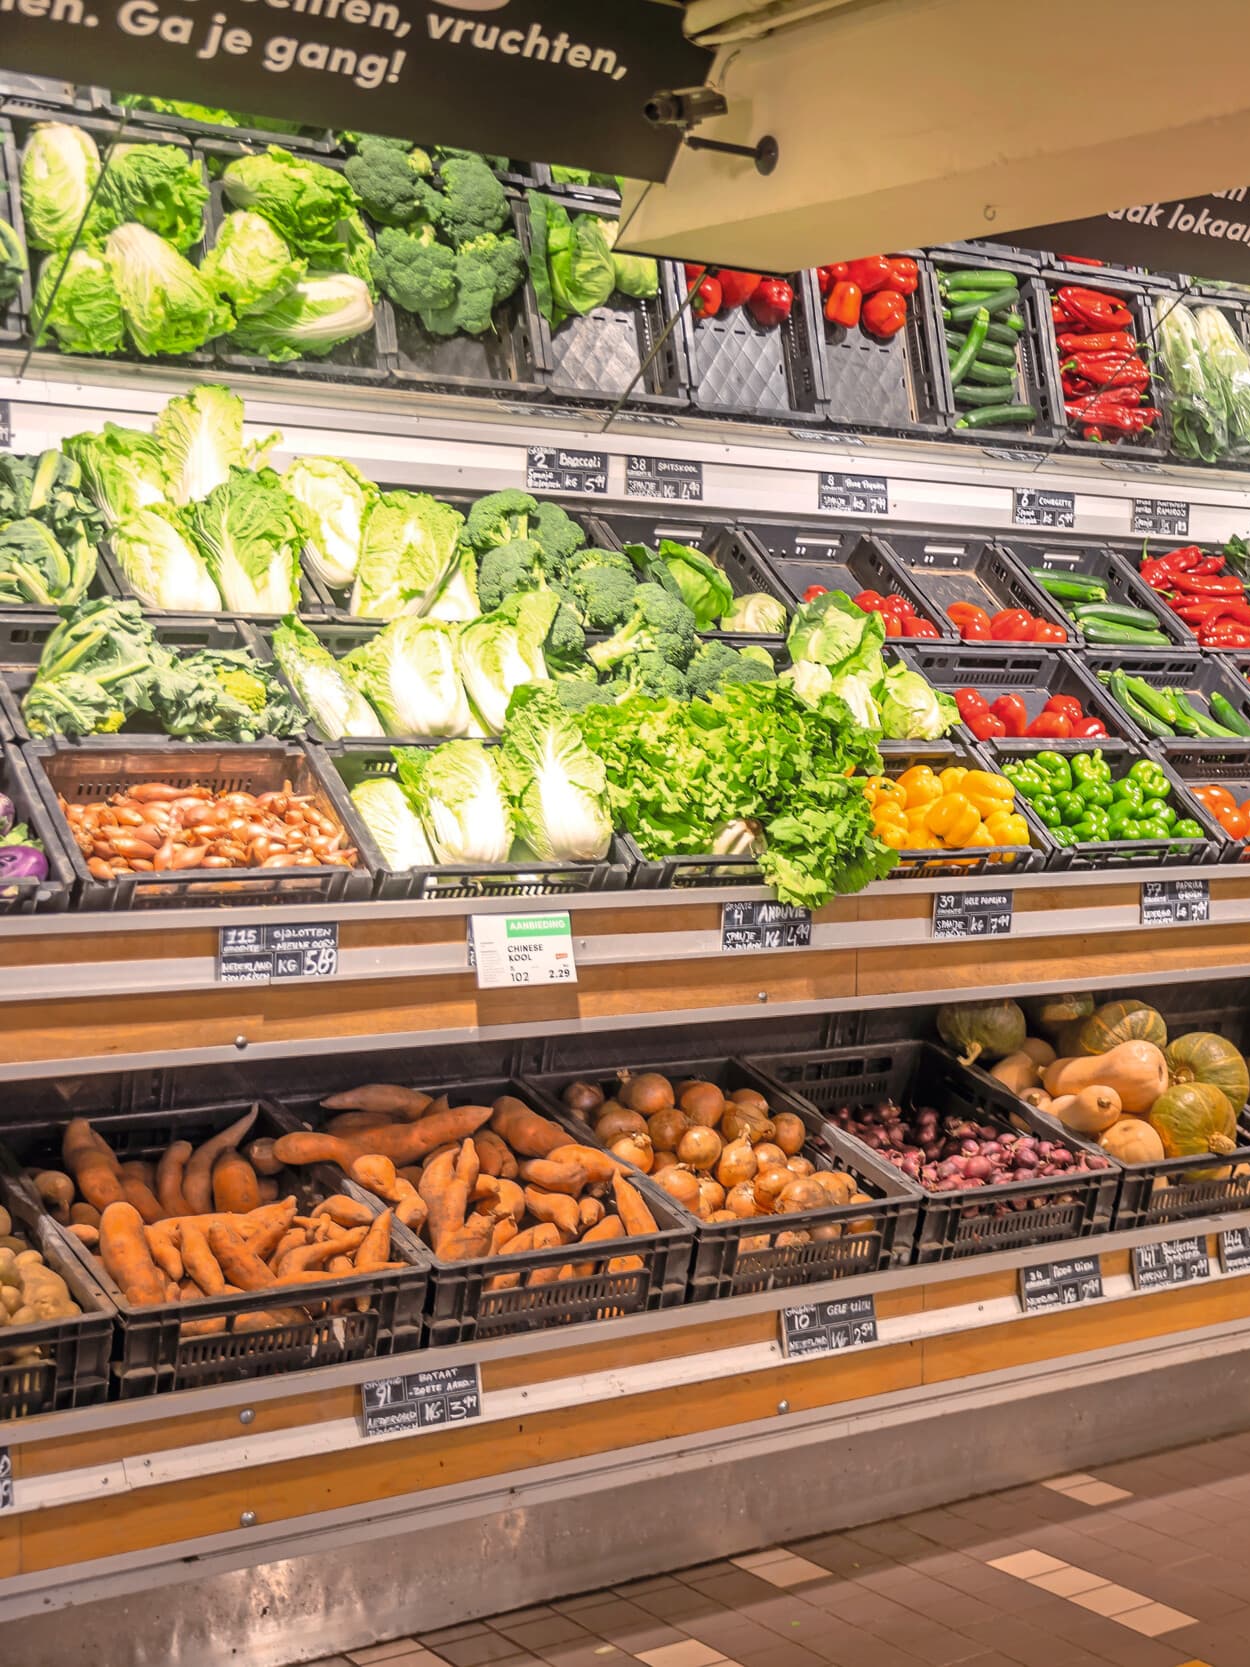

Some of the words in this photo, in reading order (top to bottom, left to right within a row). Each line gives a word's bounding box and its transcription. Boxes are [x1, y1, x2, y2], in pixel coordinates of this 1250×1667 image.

[118, 0, 194, 44] Ga
[197, 13, 252, 59] je
[263, 36, 407, 89] gang!
[428, 13, 628, 80] vruchten,
[631, 457, 646, 471] 38
[940, 896, 955, 908] 39
[510, 919, 566, 930] AANBIEDING
[227, 930, 258, 945] 115
[507, 944, 544, 953] CHINESE
[508, 954, 532, 962] KOOL
[278, 959, 299, 973] KG
[510, 971, 529, 982] 102
[548, 969, 571, 979] 2.29
[795, 1315, 810, 1330] 10
